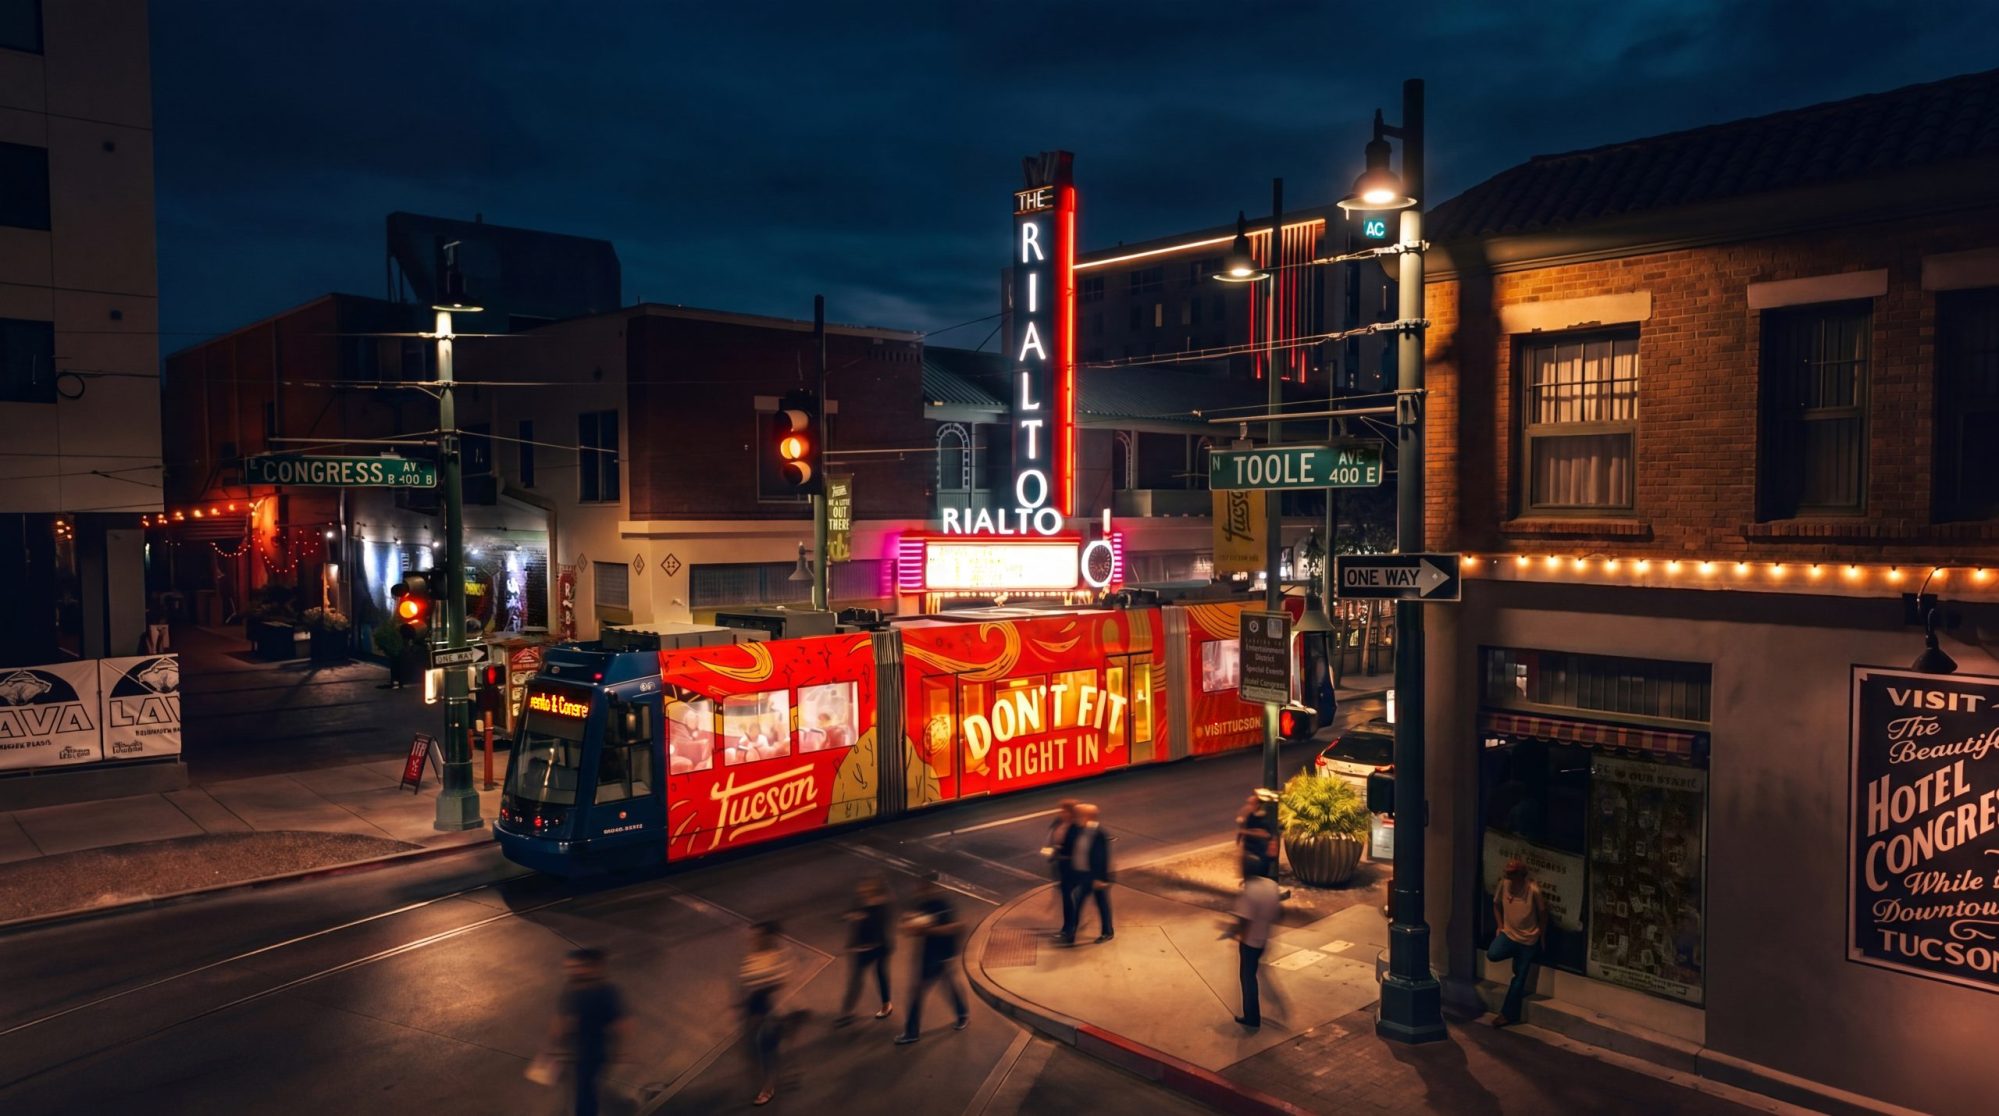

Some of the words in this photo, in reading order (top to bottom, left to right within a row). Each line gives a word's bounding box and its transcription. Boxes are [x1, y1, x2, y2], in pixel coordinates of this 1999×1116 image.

[1019, 190, 1046, 211] THE
[1366, 221, 1385, 237] AC
[1016, 222, 1049, 510] RIALTO
[263, 461, 384, 484] CONGRESS
[1212, 455, 1221, 471] N
[1233, 452, 1316, 485] TOOLE
[1338, 453, 1365, 466] AVE
[1328, 468, 1360, 484] 400
[1366, 467, 1376, 484] E
[828, 518, 850, 531] THERE
[833, 506, 847, 518] OUT
[942, 507, 1063, 536] RIALTO
[1346, 569, 1379, 586] ONE
[1385, 568, 1421, 586] WAY
[437, 655, 454, 664] ONE
[457, 651, 474, 660] WAY
[1886, 686, 1987, 713] VISIT
[963, 684, 1068, 761] DON'T
[1077, 688, 1129, 736] FIT
[1887, 715, 1941, 741] The
[998, 738, 1067, 781] RIGHT
[1077, 734, 1099, 765] IN
[1889, 727, 1999, 765] Beautif
[709, 763, 819, 852] Tucson
[1866, 759, 1972, 837] HOTEL
[1865, 787, 1999, 893] CONGRE
[1903, 869, 1985, 896] While
